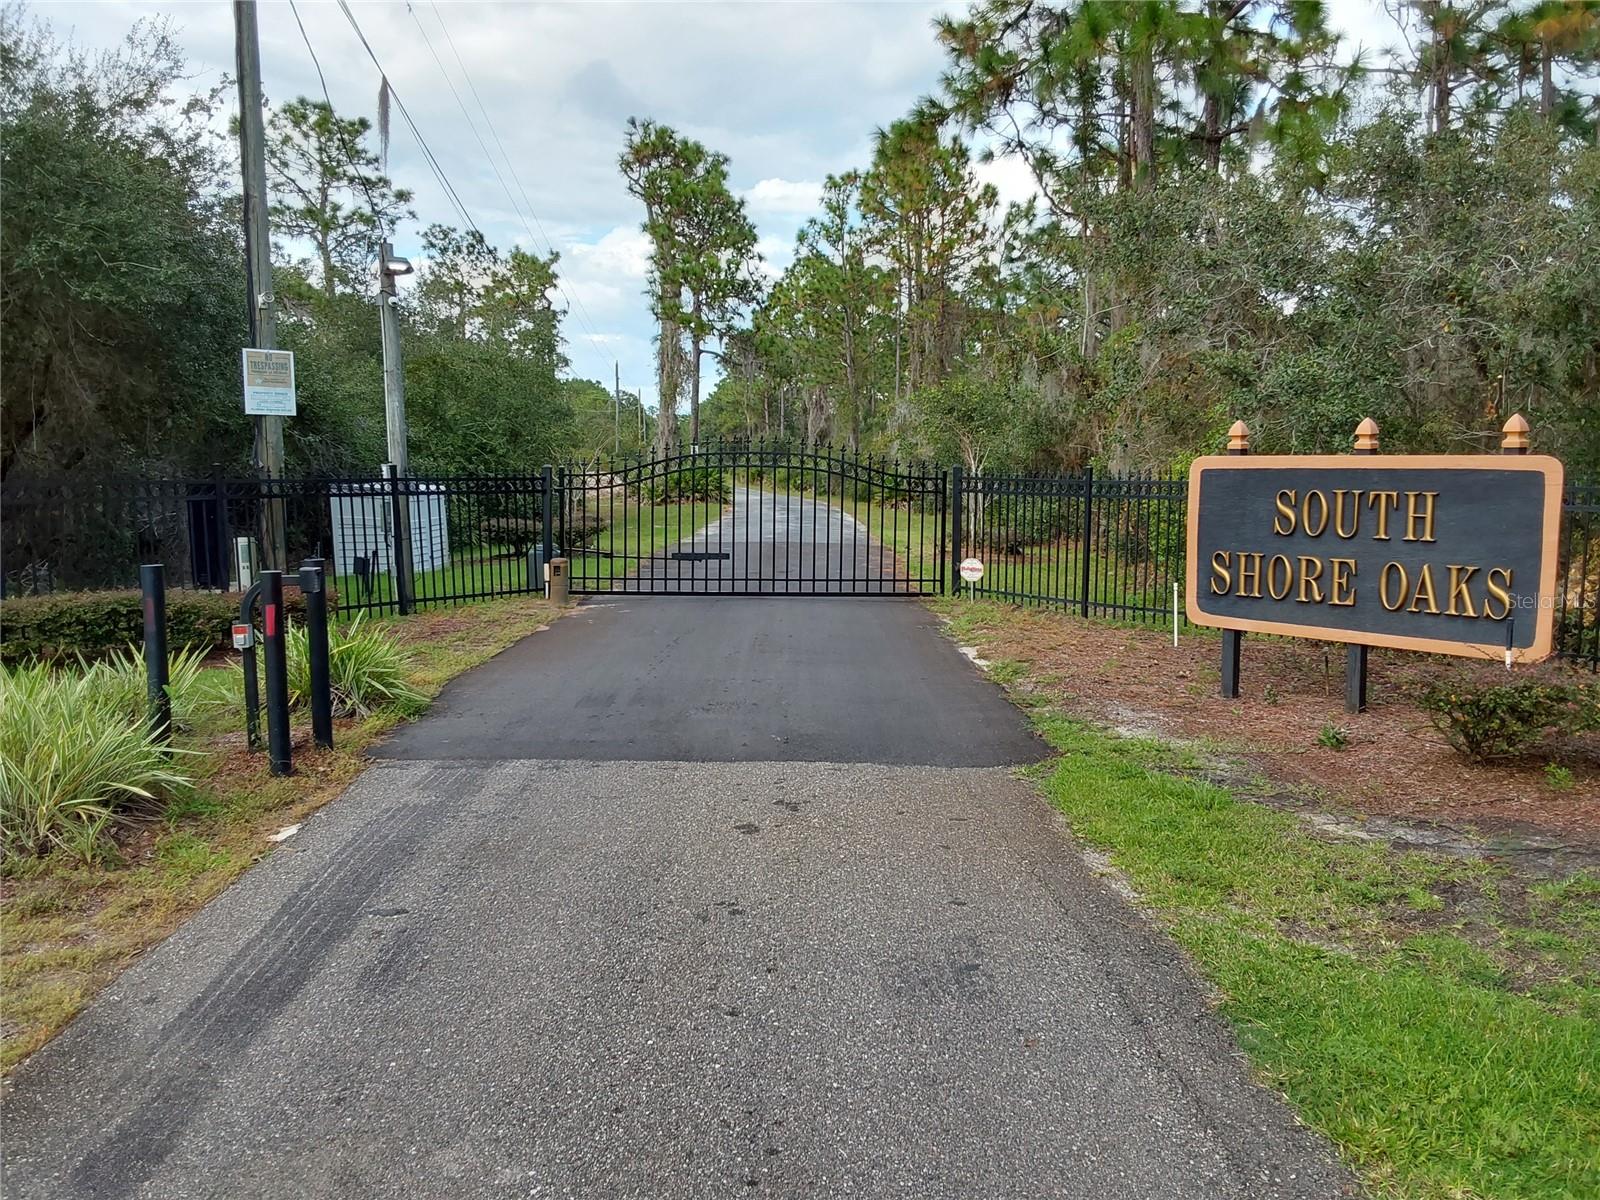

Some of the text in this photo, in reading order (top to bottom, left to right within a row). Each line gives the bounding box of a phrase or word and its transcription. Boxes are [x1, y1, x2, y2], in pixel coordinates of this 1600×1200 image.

[250, 360, 289, 371] TRESPASSING
[264, 353, 272, 361] NO
[1274, 489, 1438, 542] SOUTH
[1210, 551, 1512, 620] SHORE OAKS
